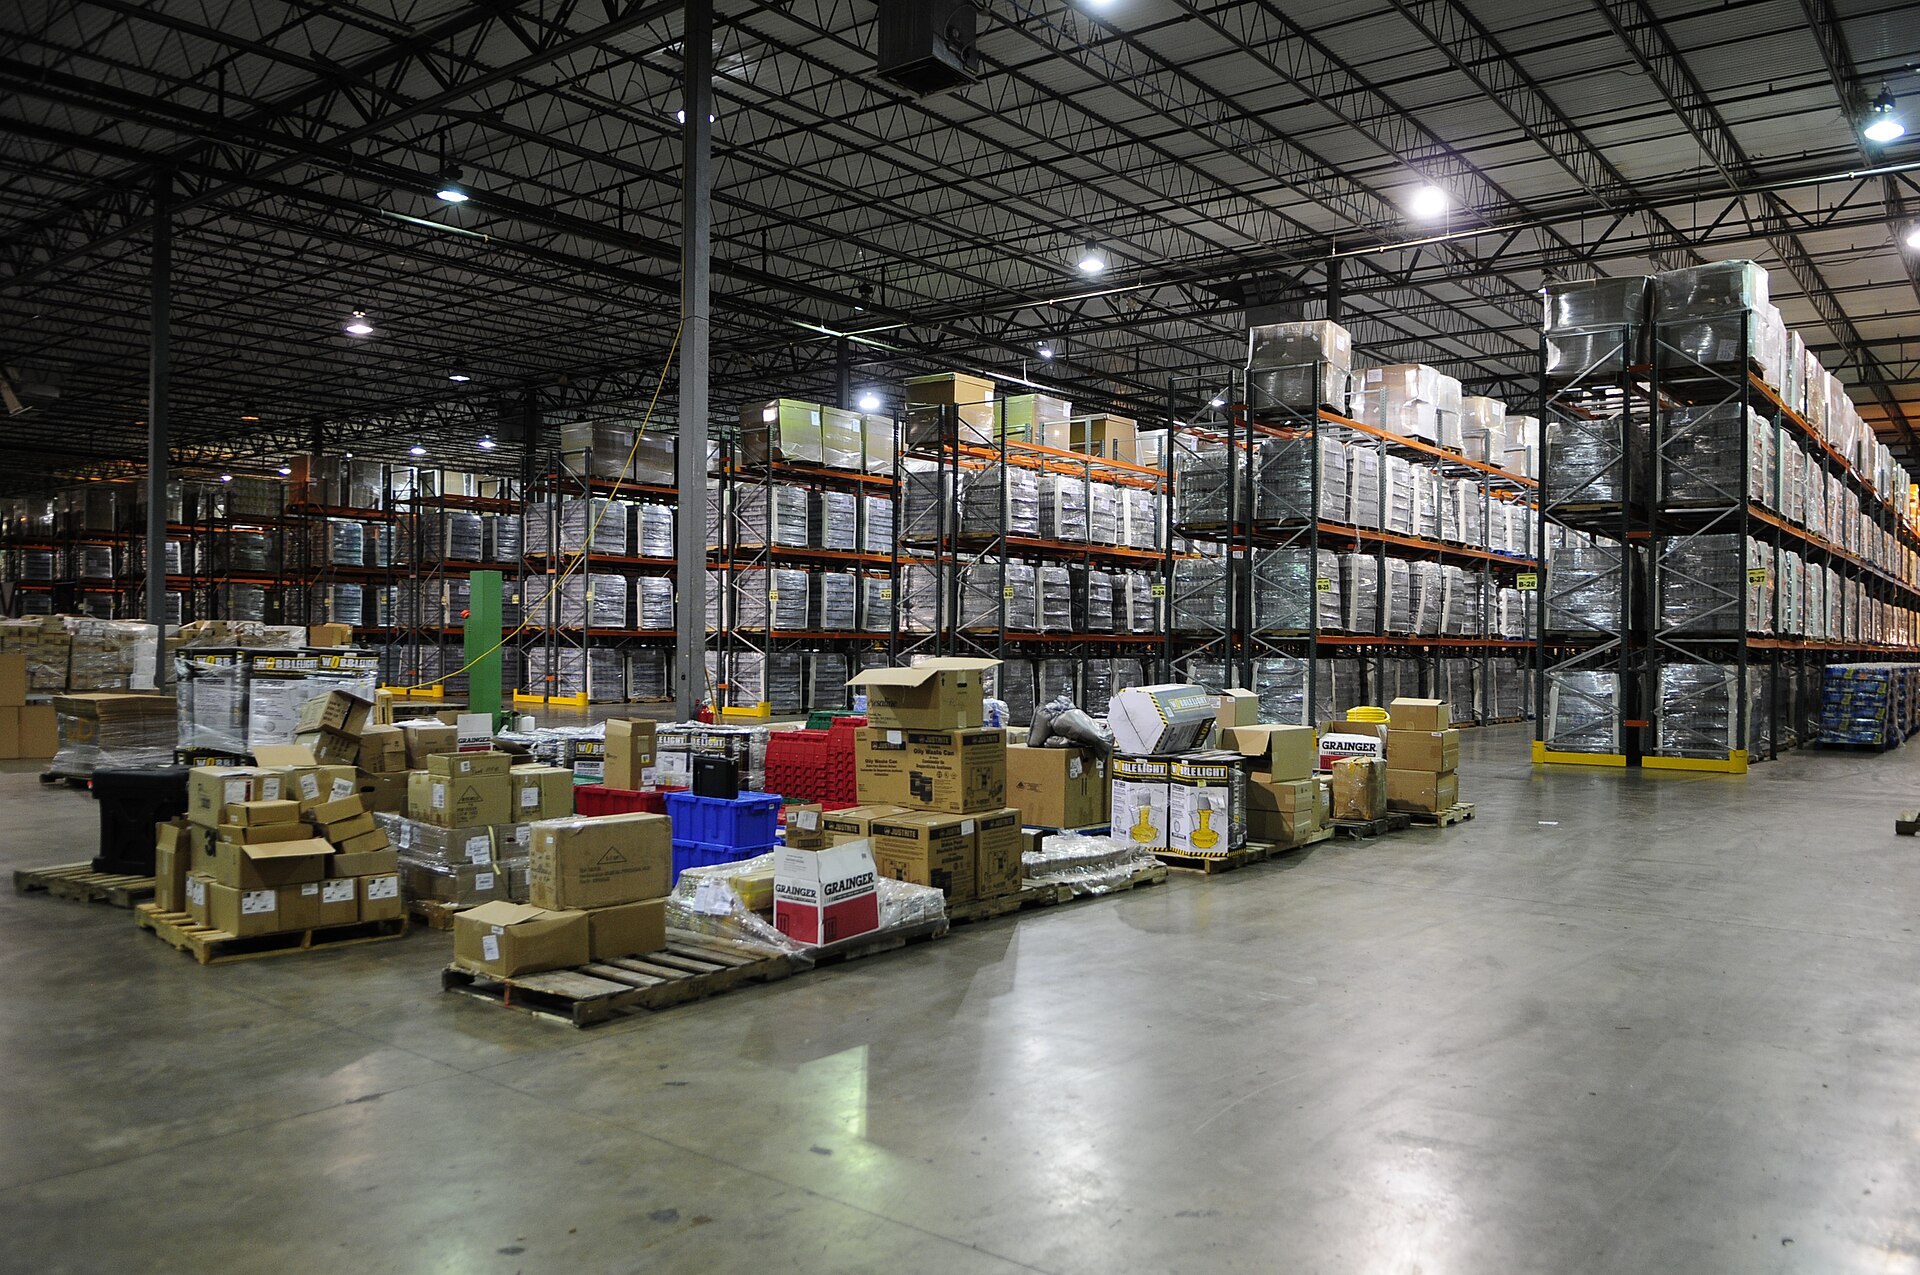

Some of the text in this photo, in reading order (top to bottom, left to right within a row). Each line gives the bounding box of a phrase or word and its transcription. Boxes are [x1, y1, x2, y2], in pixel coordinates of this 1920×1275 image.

[1322, 741, 1377, 752] GRAINGER
[835, 823, 858, 833] JUSTRITE
[891, 828, 916, 838] JUSTRITE
[824, 872, 874, 896] GRAINGER
[775, 884, 817, 898] GRAINGER
